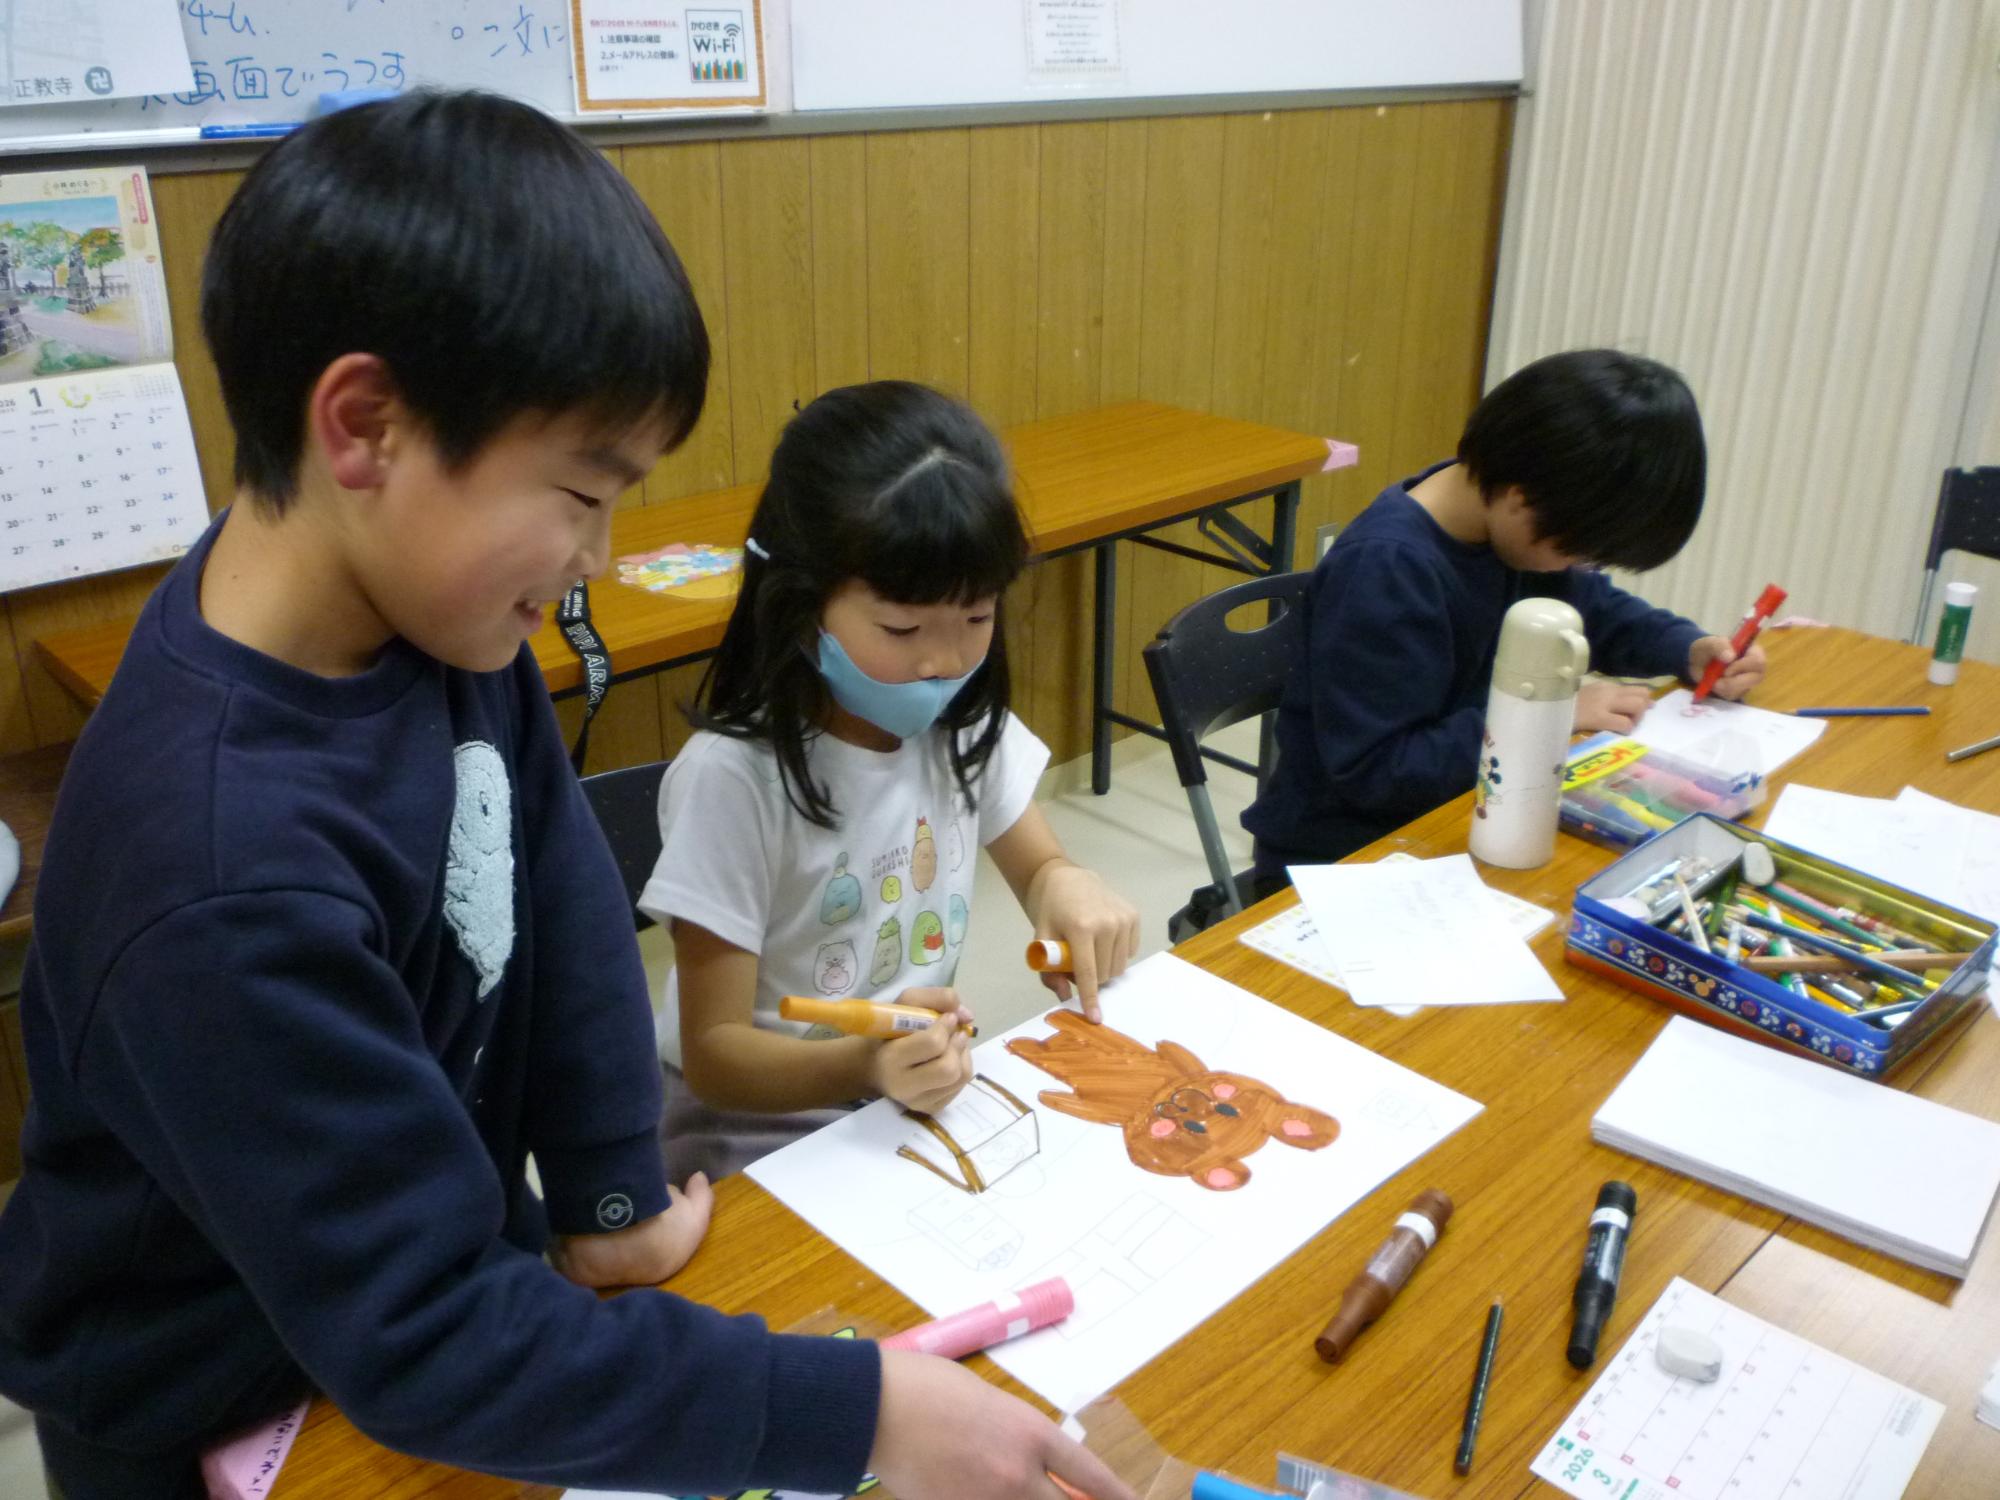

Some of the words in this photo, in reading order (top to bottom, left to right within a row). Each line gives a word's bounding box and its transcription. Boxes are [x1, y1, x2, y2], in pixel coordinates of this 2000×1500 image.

[690, 21, 720, 32] かわさき
[692, 37, 737, 53] Wi-Fi
[13, 76, 73, 98] 正教寺
[29, 387, 42, 408] 1
[110, 421, 118, 430] 2
[147, 416, 156, 424] 3
[37, 460, 44, 469] 7
[77, 454, 84, 462] 8
[115, 448, 123, 456] 9
[151, 441, 162, 450] 10
[1, 493, 13, 502] 13
[41, 487, 53, 495] 14
[81, 480, 92, 488] 15
[119, 473, 131, 482] 16
[157, 467, 167, 475] 17
[6, 519, 19, 529] 20
[47, 513, 58, 522] 21
[86, 505, 98, 514] 22
[125, 498, 137, 508] 23
[162, 492, 174, 501] 24
[12, 545, 25, 555] 27
[52, 538, 65, 548] 28
[92, 531, 104, 541] 29
[129, 524, 142, 533] 30
[167, 517, 177, 526] 31
[1562, 1448, 1595, 1482] 2026
[1592, 1468, 1612, 1486] 3
